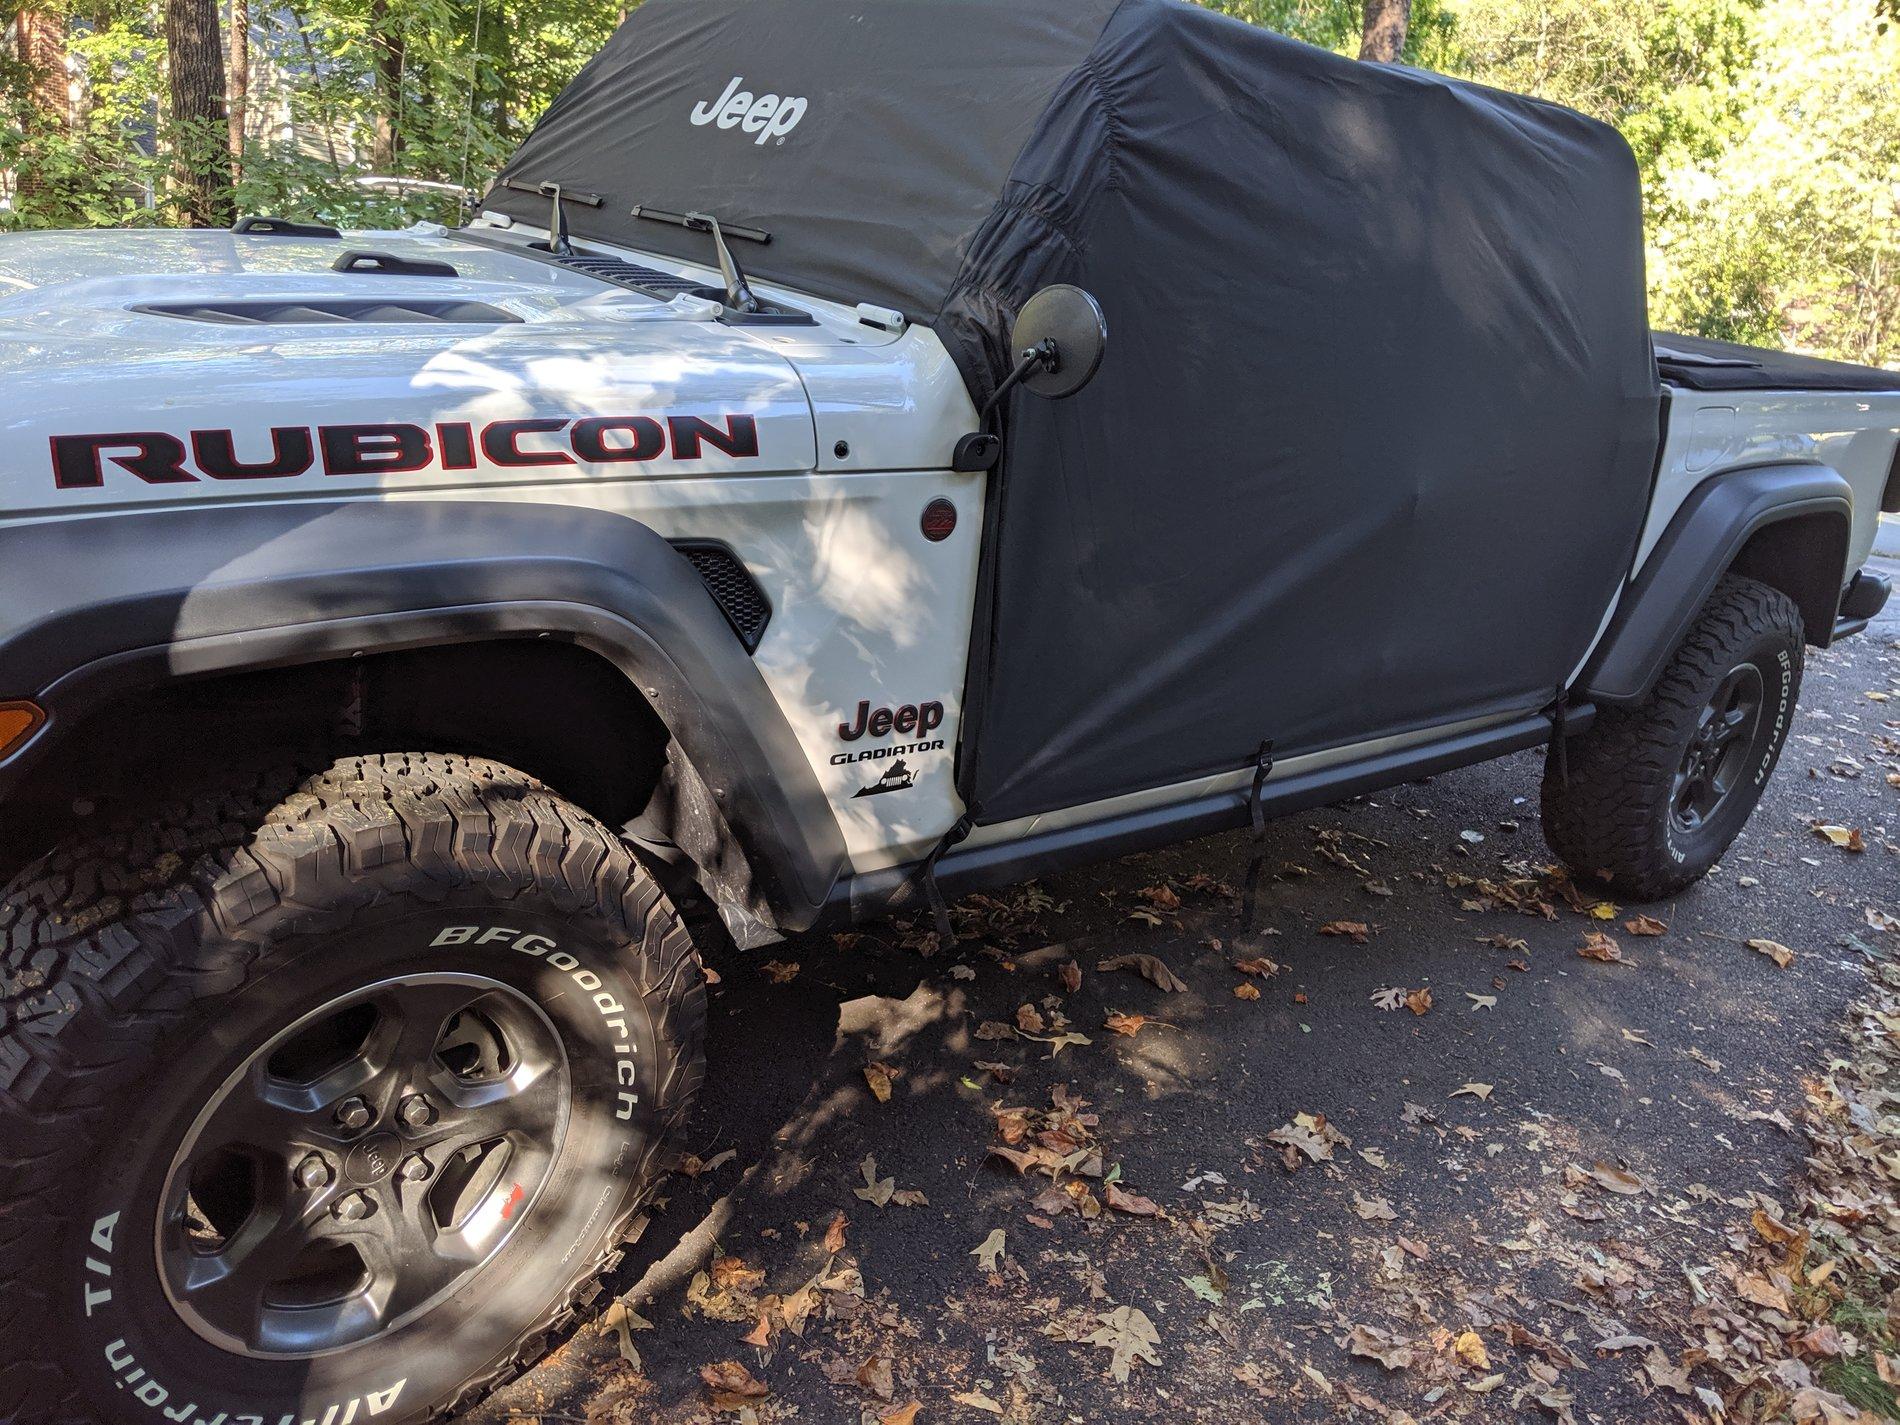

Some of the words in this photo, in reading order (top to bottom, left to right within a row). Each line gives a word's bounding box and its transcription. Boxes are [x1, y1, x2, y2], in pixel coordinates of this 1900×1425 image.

[690, 76, 808, 145] Jeep
[49, 413, 759, 490] RUBICON
[829, 739, 945, 766] GLADIATOR
[838, 700, 945, 743] Jeep
[1754, 649, 1794, 786] BFGoodrich
[428, 926, 639, 1121] BFGoodrich
[84, 1210, 121, 1318] T/A
